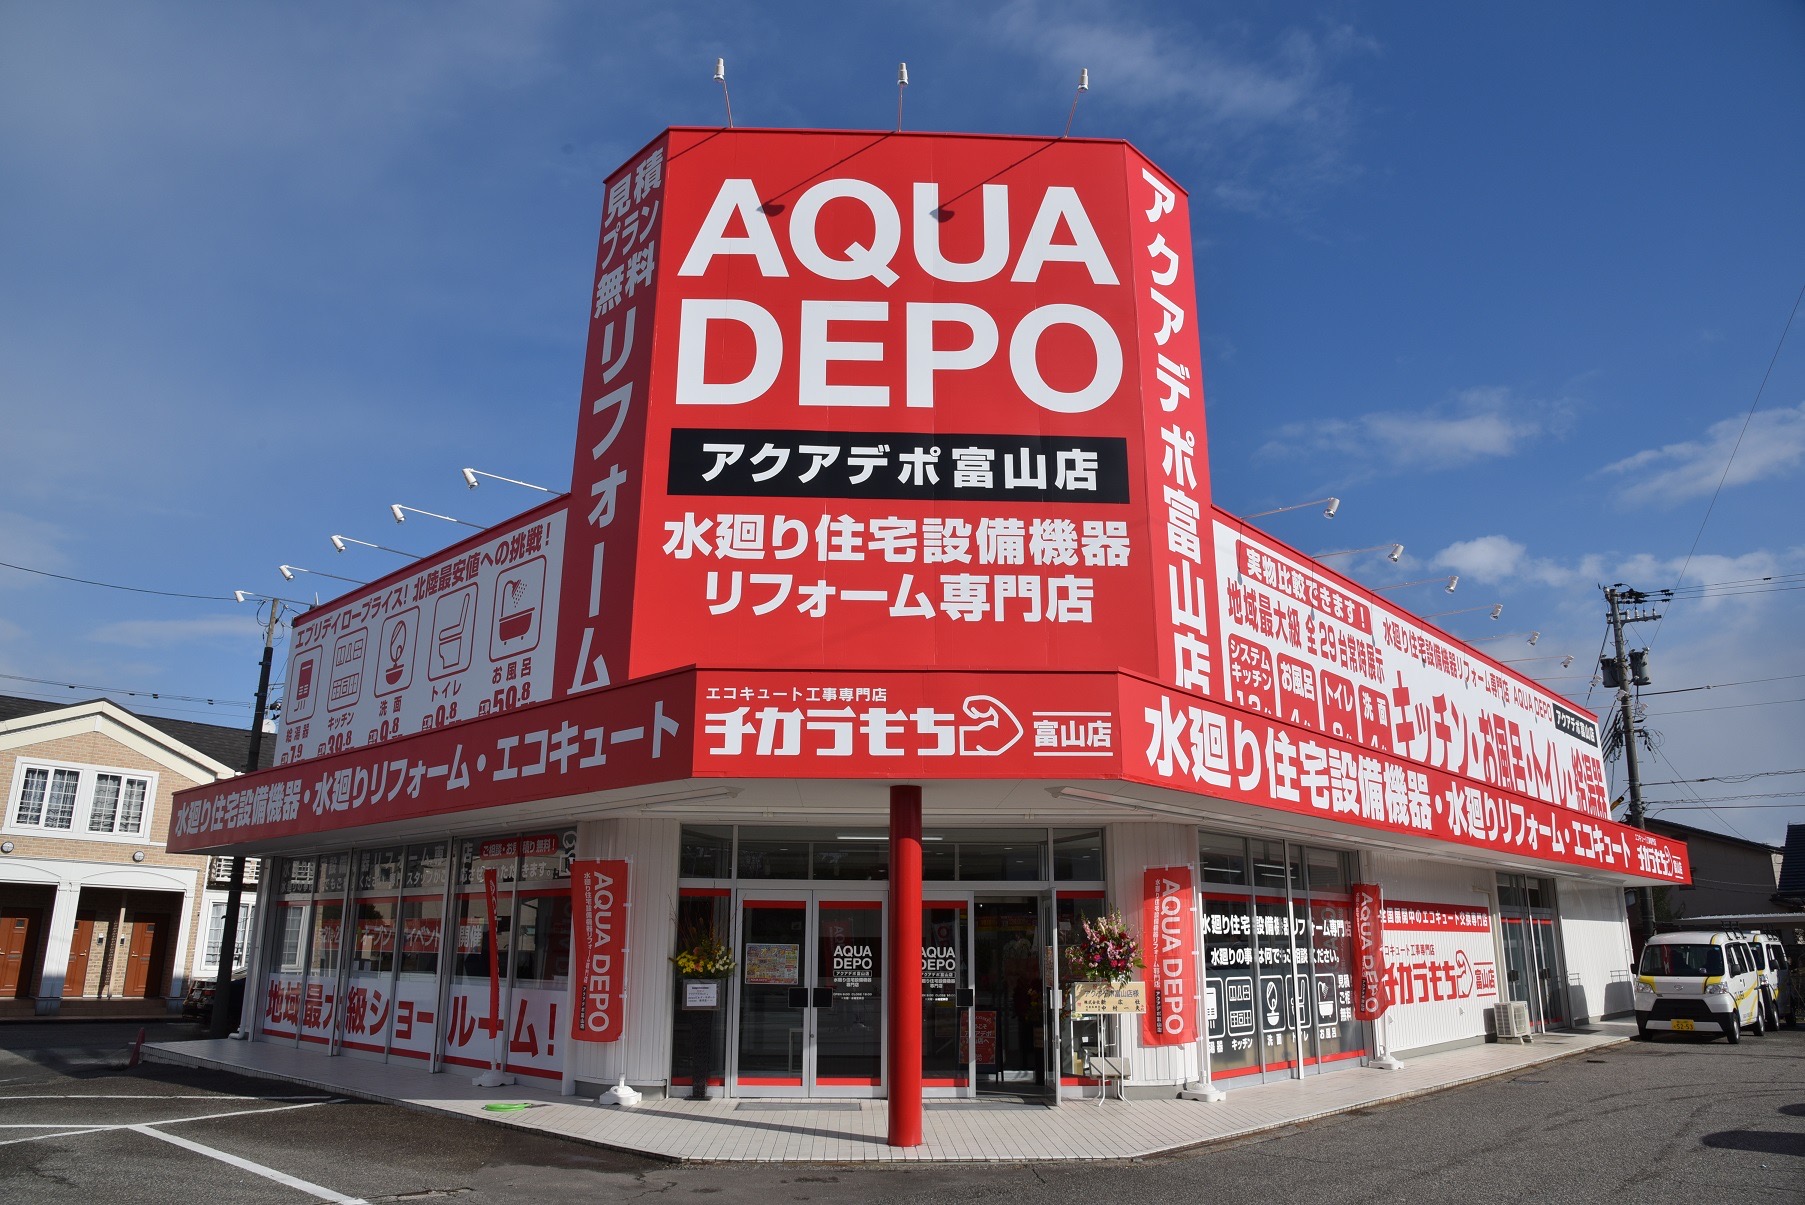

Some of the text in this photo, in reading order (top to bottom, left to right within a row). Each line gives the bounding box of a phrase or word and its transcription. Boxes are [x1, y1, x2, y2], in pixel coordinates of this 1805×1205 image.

[604, 147, 664, 228] 見積
[601, 200, 660, 270] プラン
[677, 178, 1120, 288] AQUA
[593, 240, 655, 319] 無料
[675, 299, 1123, 413] DEPO
[1140, 167, 1212, 696] アクアデポ富山店
[701, 442, 1099, 491] アクアデポ富山店
[566, 306, 638, 695] リフォーム
[662, 513, 1130, 567] 水廻り住宅設備機器
[706, 570, 1094, 623] リフォーム専門店
[1227, 577, 1302, 649] 地域最大級
[1230, 639, 1271, 671] システム
[1231, 662, 1272, 691] キッチン
[1280, 661, 1316, 702] お風呂
[431, 680, 462, 702] トイレ
[706, 687, 887, 702] エコキュート工事専門店
[1324, 677, 1353, 712] トイレ
[1033, 720, 1112, 748] 富山店
[174, 700, 680, 838] 水廻り住宅設備機器・水廻りリフォーム・エコキュート
[588, 871, 614, 1032] AQUA DEPO
[833, 945, 873, 957] AQUA
[833, 957, 873, 969] DEPO
[1161, 878, 1184, 1034] AQUA DEPO
[1232, 1038, 1253, 1050] キッチン
